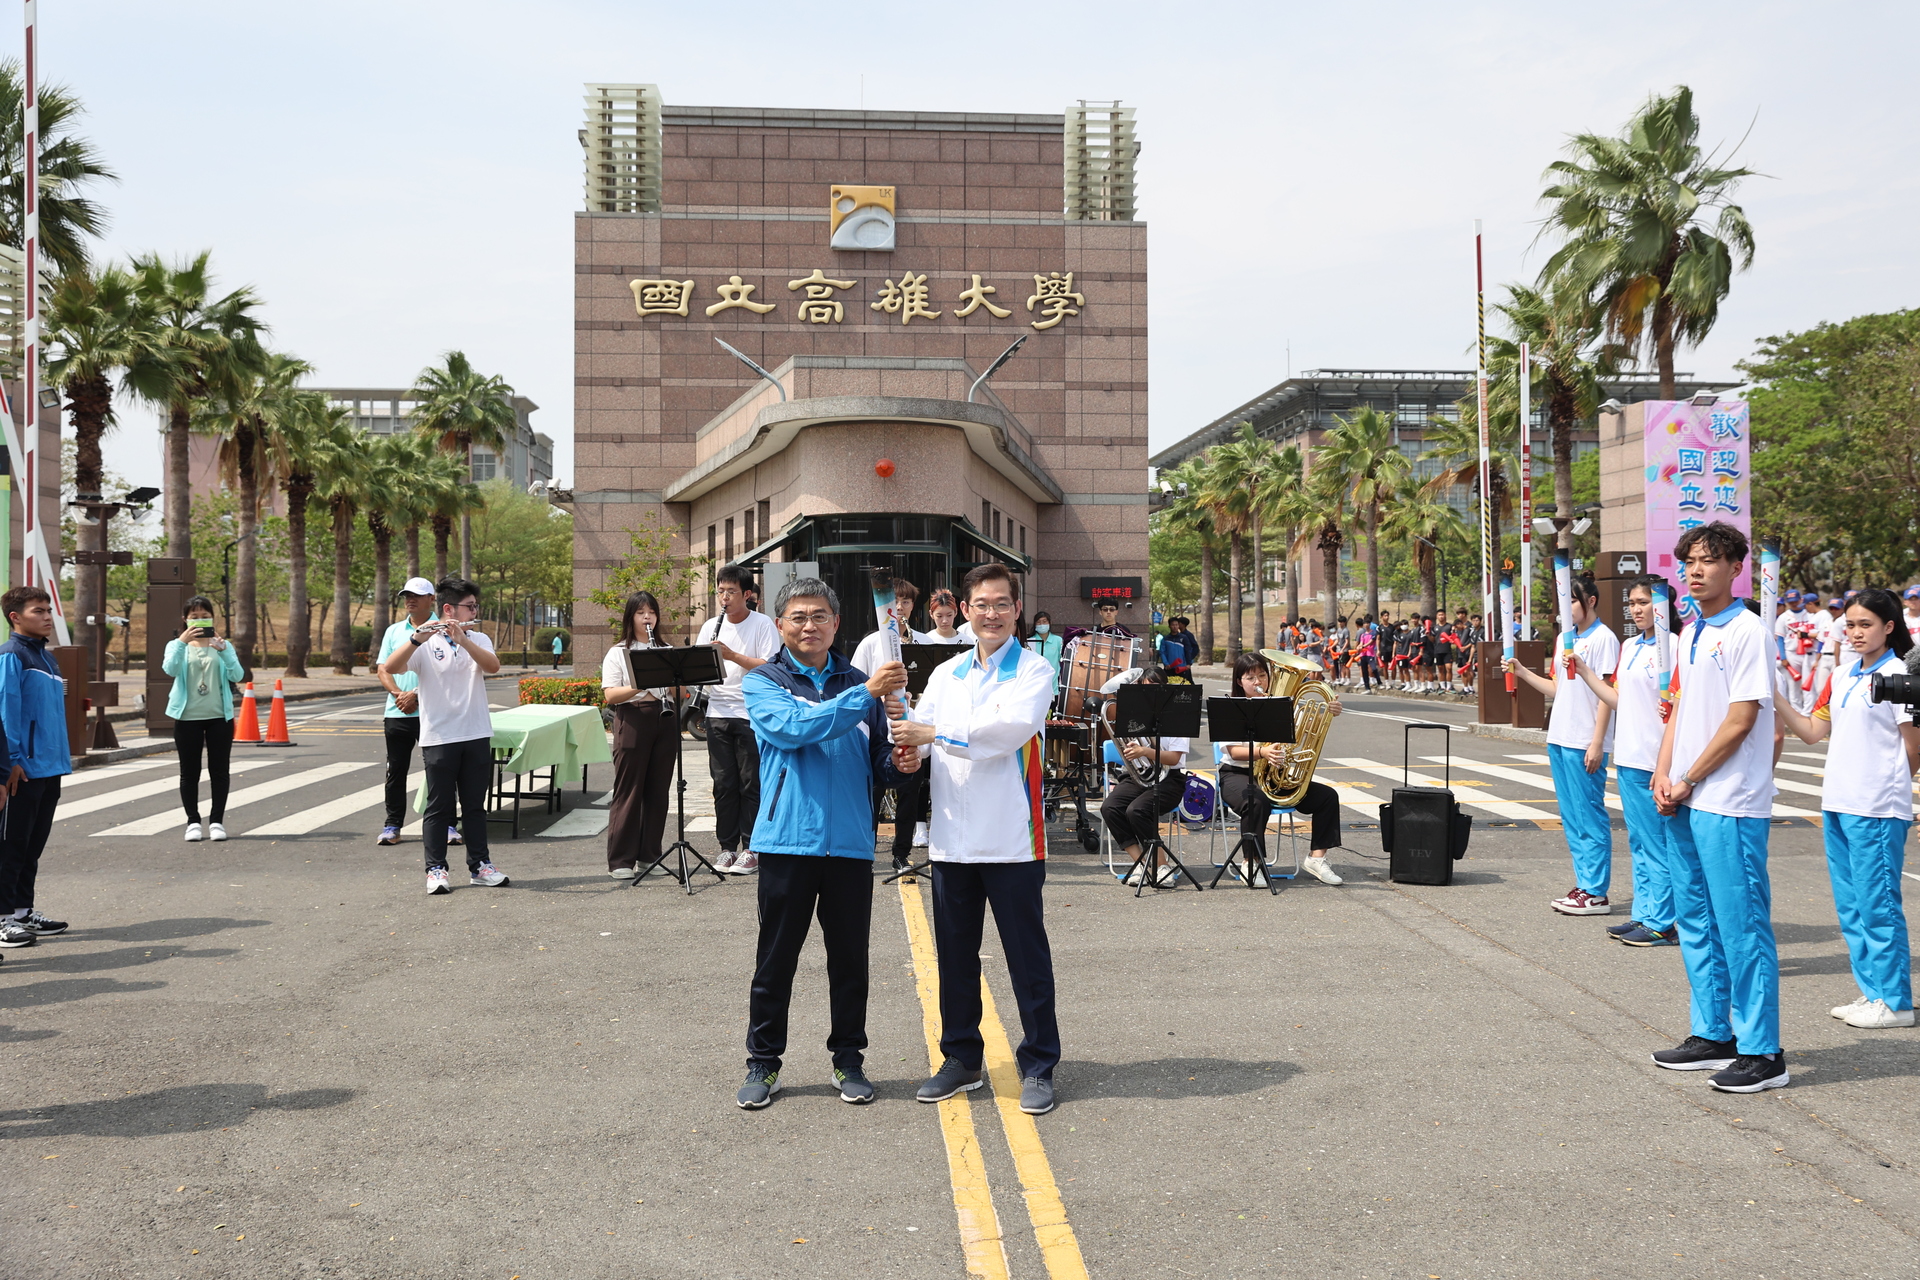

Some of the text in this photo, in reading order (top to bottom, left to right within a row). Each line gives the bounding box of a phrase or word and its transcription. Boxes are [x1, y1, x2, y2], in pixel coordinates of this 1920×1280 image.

[630, 268, 1085, 330] 國立高雄大學
[1709, 412, 1740, 513] 歡迎您
[1409, 849, 1432, 858] TEV
